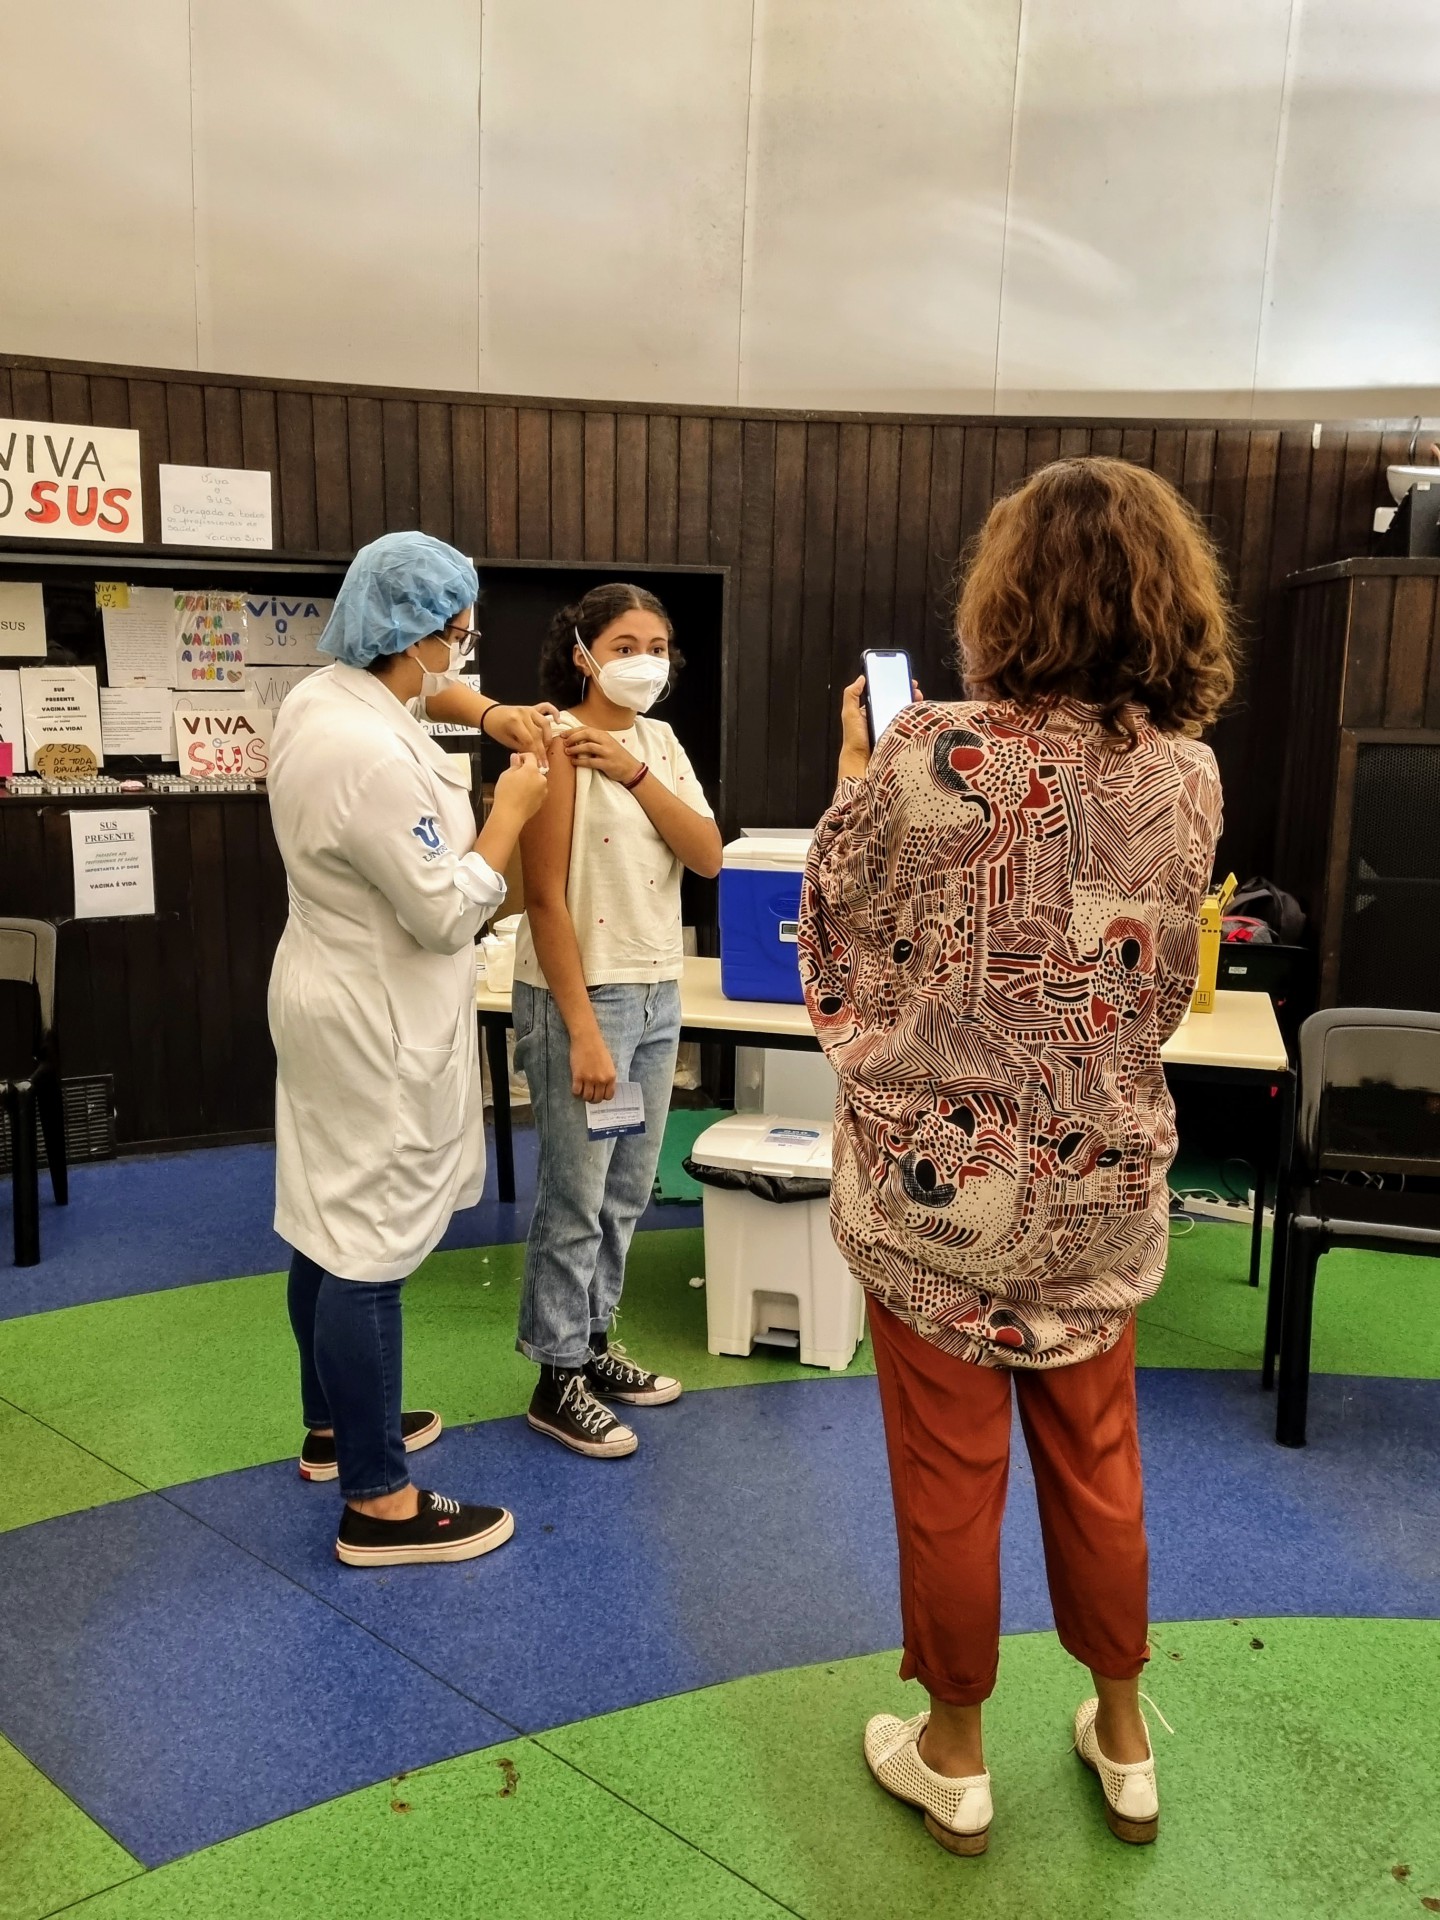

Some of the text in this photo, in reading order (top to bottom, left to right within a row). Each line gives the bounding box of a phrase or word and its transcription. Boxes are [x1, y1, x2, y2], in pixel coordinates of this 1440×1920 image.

[0, 432, 106, 482] VIVA
[25, 480, 132, 533] SUS
[0, 621, 26, 631] SUS
[264, 635, 297, 647] SUS
[182, 716, 256, 735] VIVA
[59, 744, 81, 753] SUS
[54, 758, 65, 766] DE
[188, 738, 269, 777] SUS
[99, 821, 118, 831] SUS
[84, 832, 135, 844] PRESENTE
[90, 882, 115, 890] VACINA
